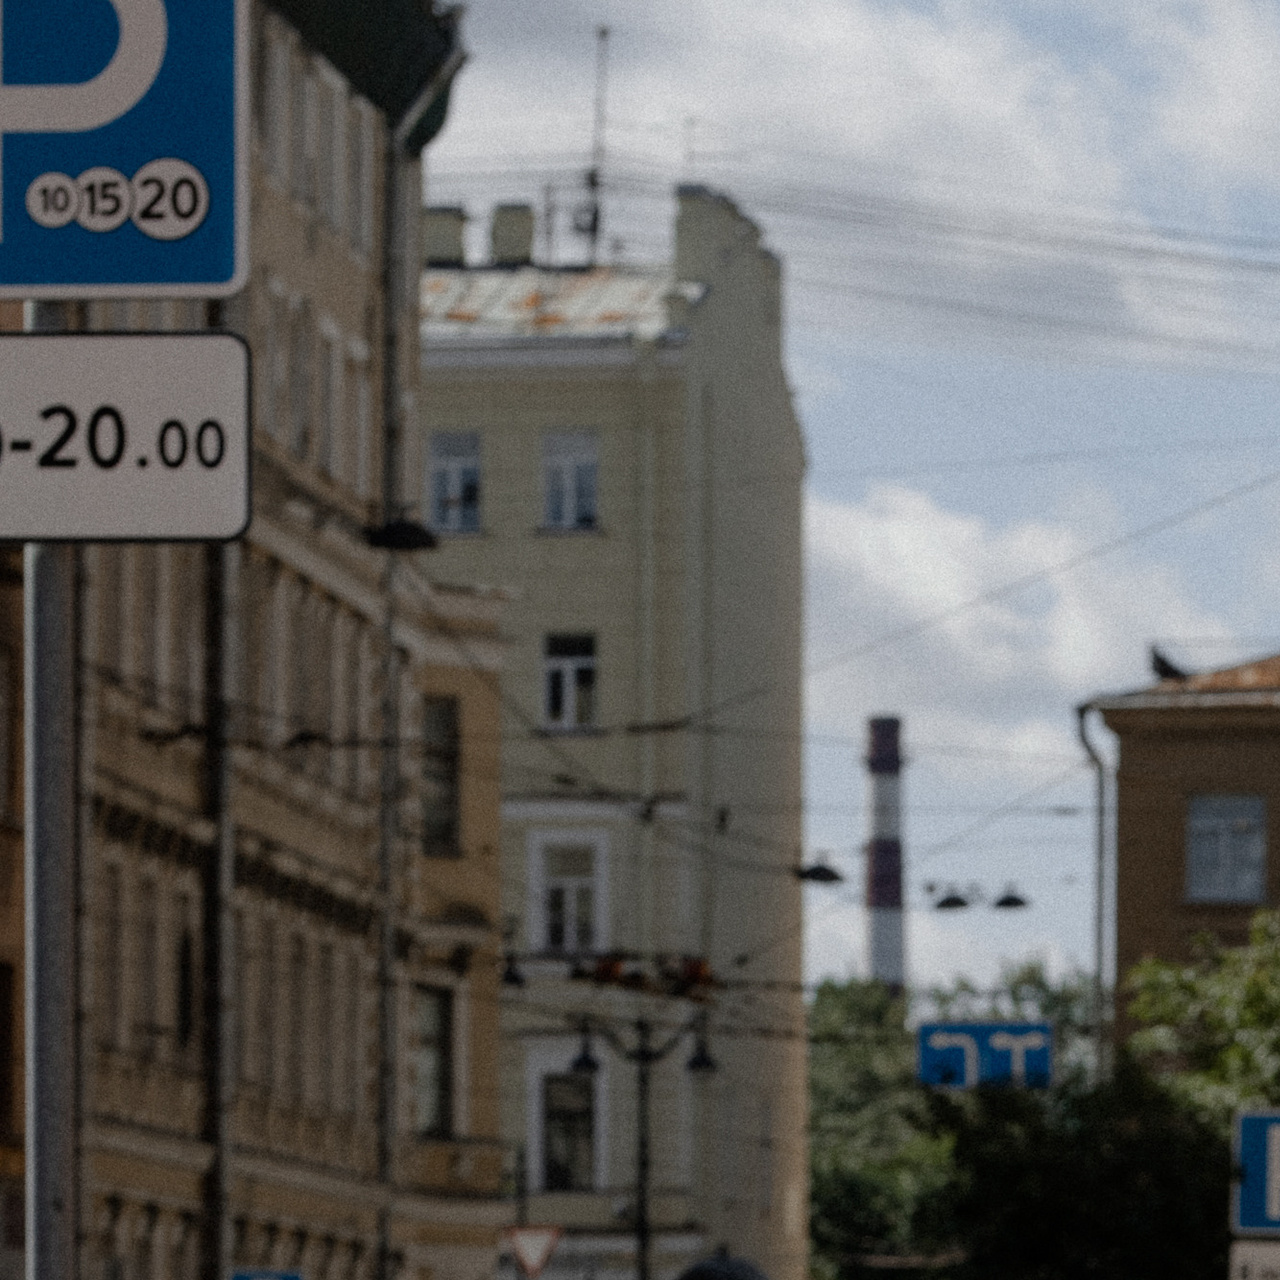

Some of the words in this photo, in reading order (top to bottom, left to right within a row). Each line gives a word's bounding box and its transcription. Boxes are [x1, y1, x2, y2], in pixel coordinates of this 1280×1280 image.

[40, 185, 70, 213] 10
[85, 181, 121, 217] 15
[138, 176, 199, 220] 20
[0, 404, 226, 470] -20.00
